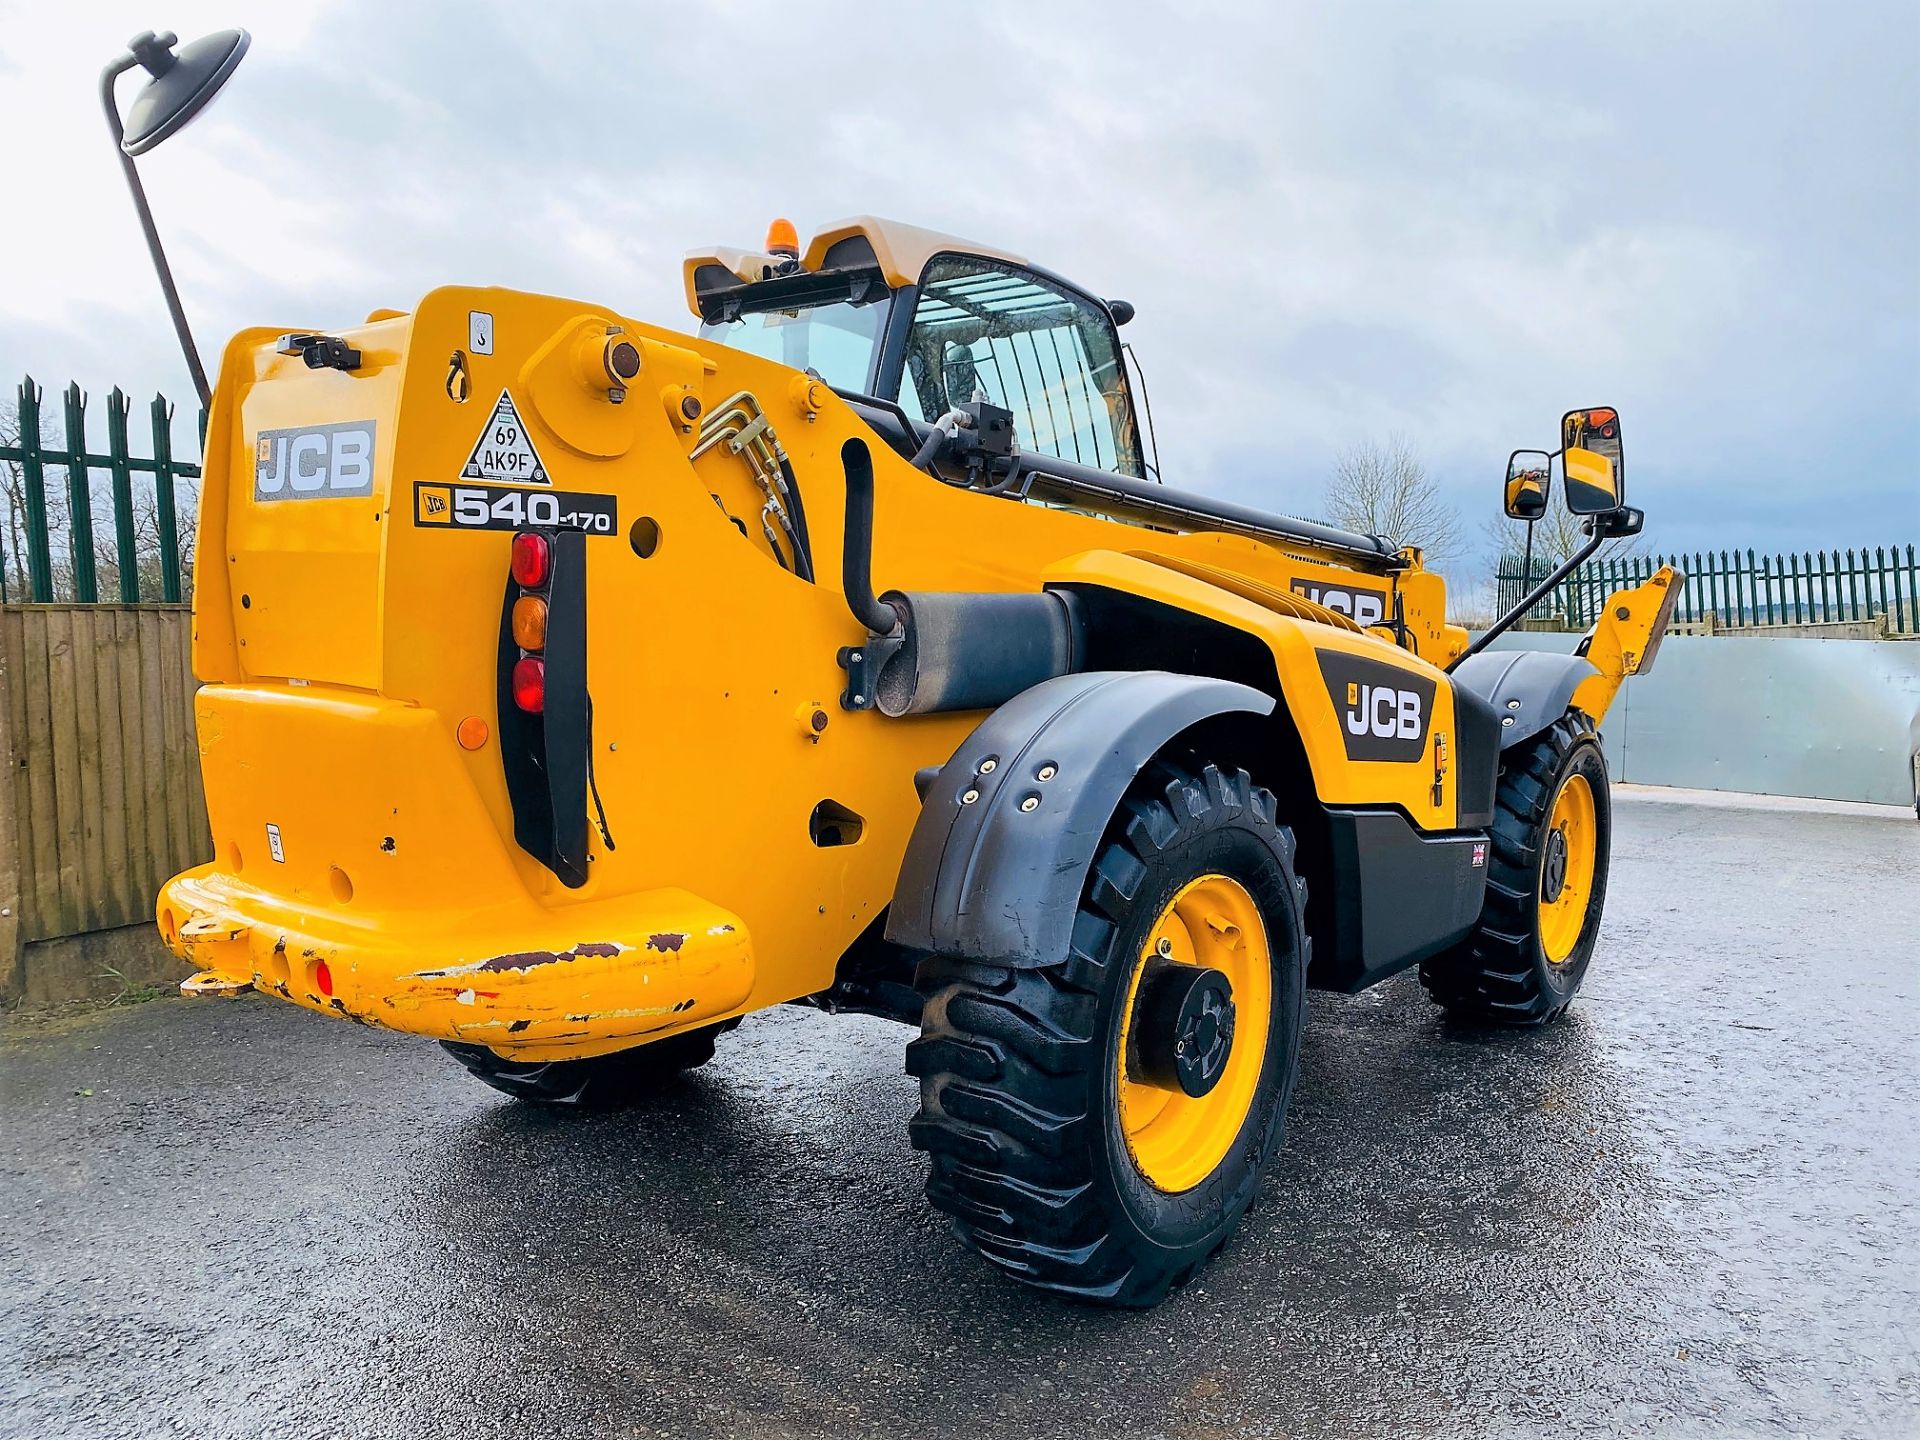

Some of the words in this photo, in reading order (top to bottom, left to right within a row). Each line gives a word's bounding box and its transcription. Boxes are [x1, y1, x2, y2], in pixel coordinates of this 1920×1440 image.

[496, 426, 517, 446] 69
[258, 431, 371, 493] JCB
[484, 450, 529, 472] AK9F
[427, 495, 446, 513] JCB
[1347, 684, 1421, 740] JCB
